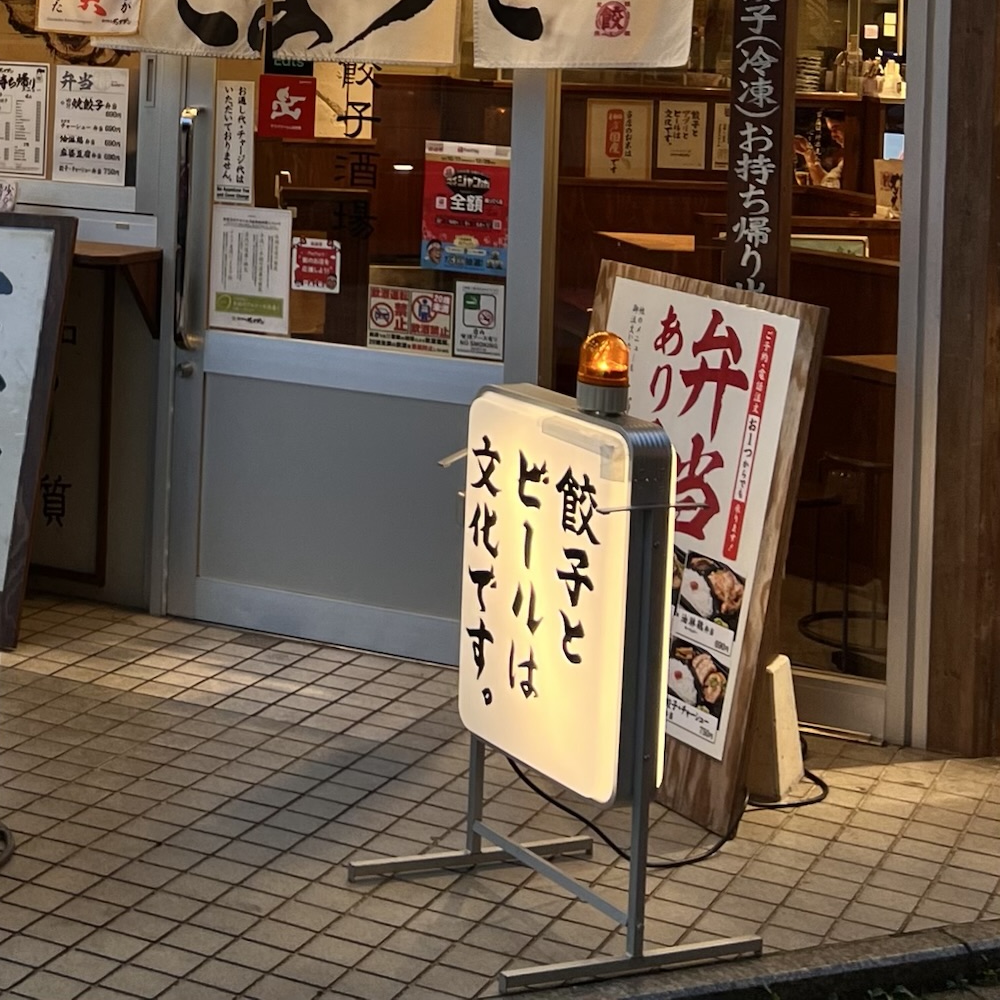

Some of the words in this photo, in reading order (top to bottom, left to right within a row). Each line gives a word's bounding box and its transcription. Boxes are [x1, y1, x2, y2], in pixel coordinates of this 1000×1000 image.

[60, 70, 93, 91] 弁当
[222, 86, 234, 183] いただいておりません。
[236, 86, 246, 184] お通し代・チャージ代は
[450, 193, 483, 214] 全額
[673, 309, 749, 541] 弁当
[41, 475, 73, 528] 質
[466, 435, 502, 706] 文化です。
[507, 450, 549, 700] ビールは
[556, 465, 601, 665] 餃子と
